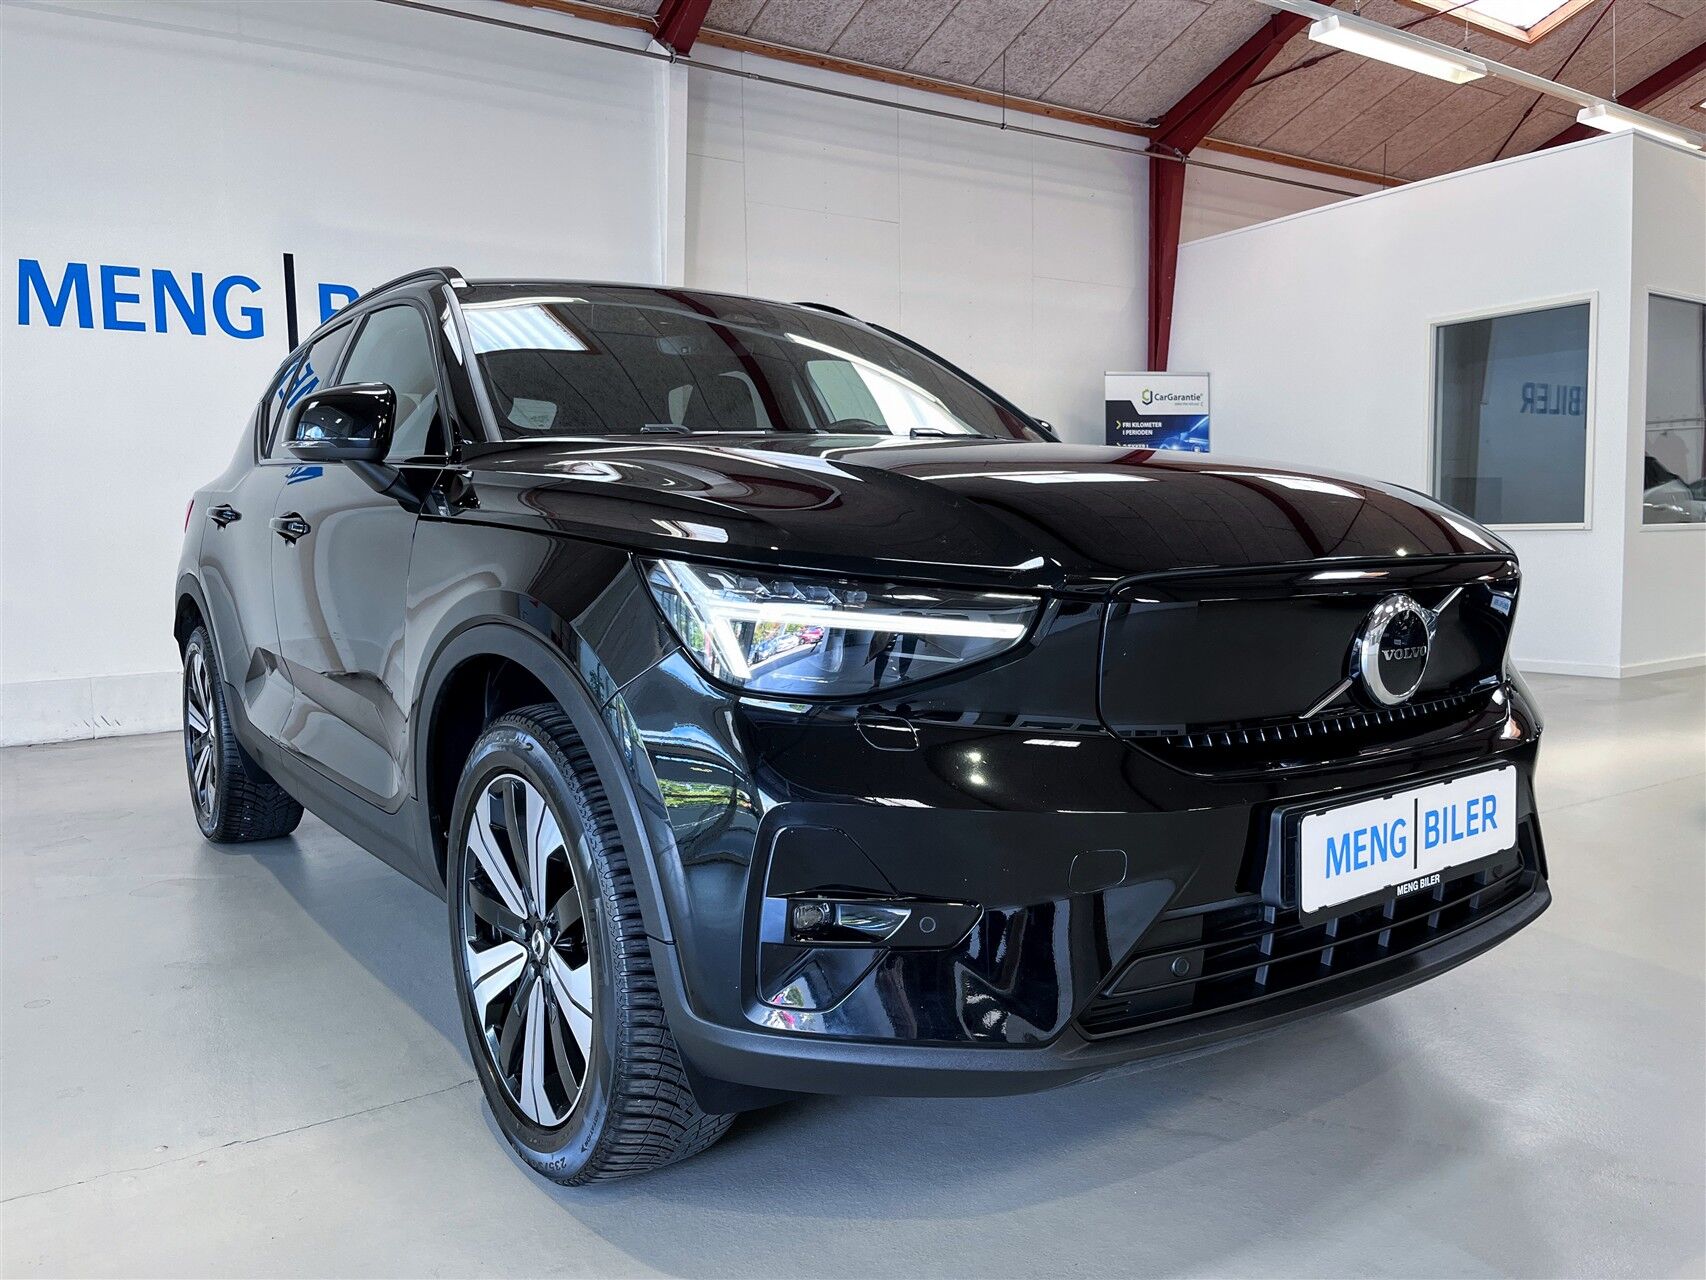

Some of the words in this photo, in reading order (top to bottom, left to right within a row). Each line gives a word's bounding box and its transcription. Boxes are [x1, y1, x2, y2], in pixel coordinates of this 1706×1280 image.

[18, 258, 265, 340] MENG
[1154, 392, 1201, 401] CarGarantie
[1381, 645, 1427, 661] VOLVO
[1325, 818, 1407, 879] MENG
[1424, 794, 1498, 850] BILER
[1397, 880, 1419, 896] MENG
[1420, 873, 1441, 889] BILER
